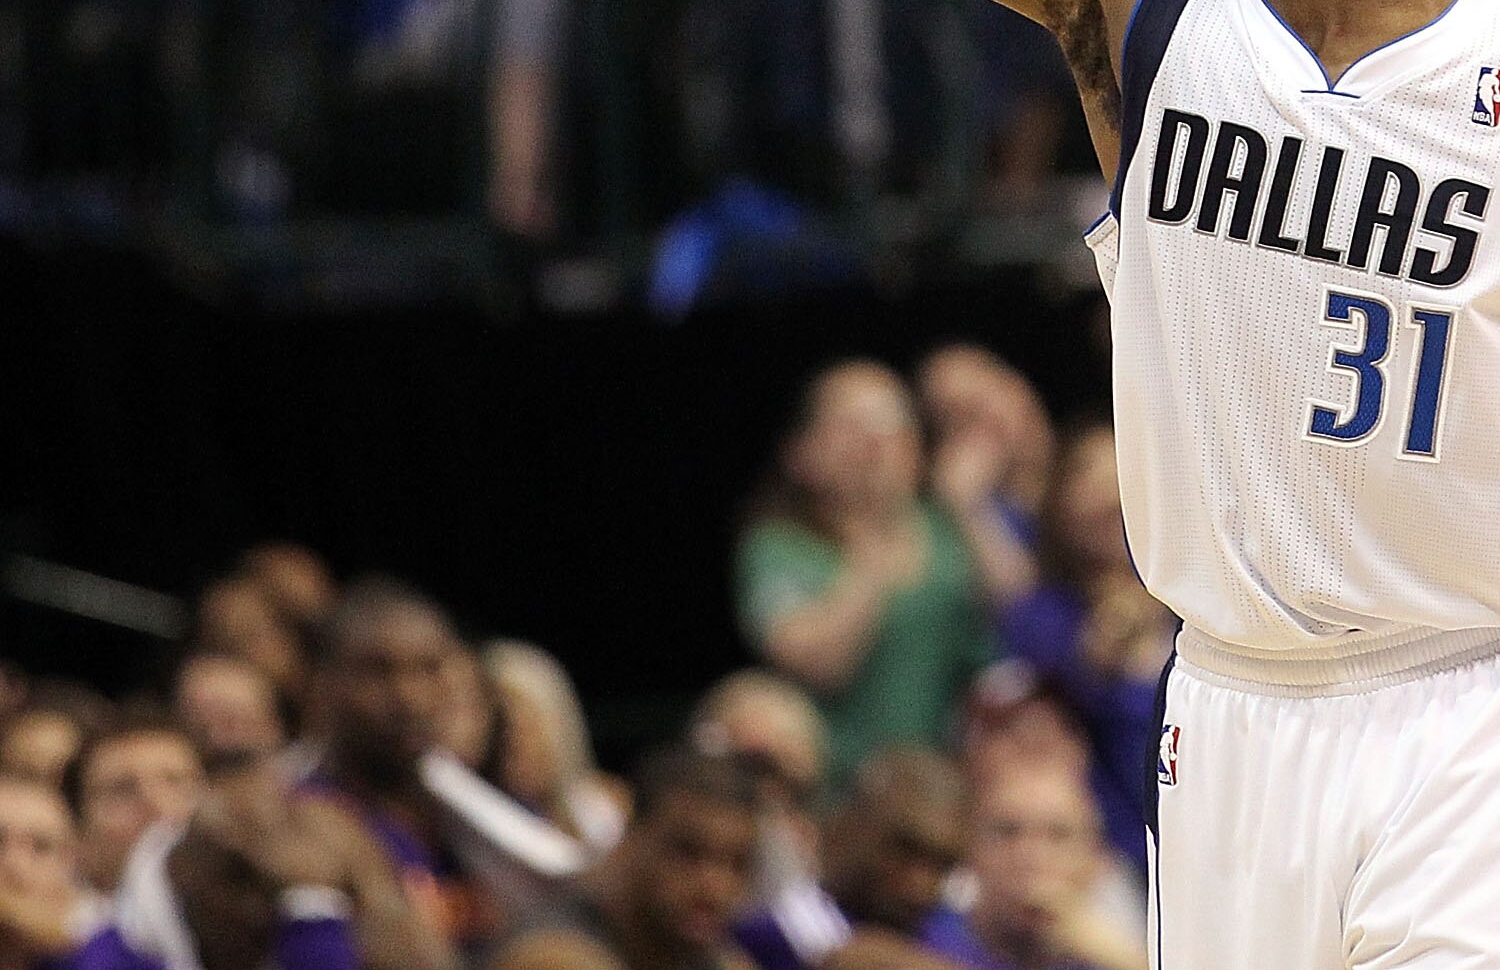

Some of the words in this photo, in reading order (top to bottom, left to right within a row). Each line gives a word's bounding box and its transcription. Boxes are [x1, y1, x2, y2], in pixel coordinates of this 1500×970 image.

[1147, 107, 1493, 287] DALLAS
[1473, 111, 1491, 125] NBA
[1306, 287, 1458, 459] 31
